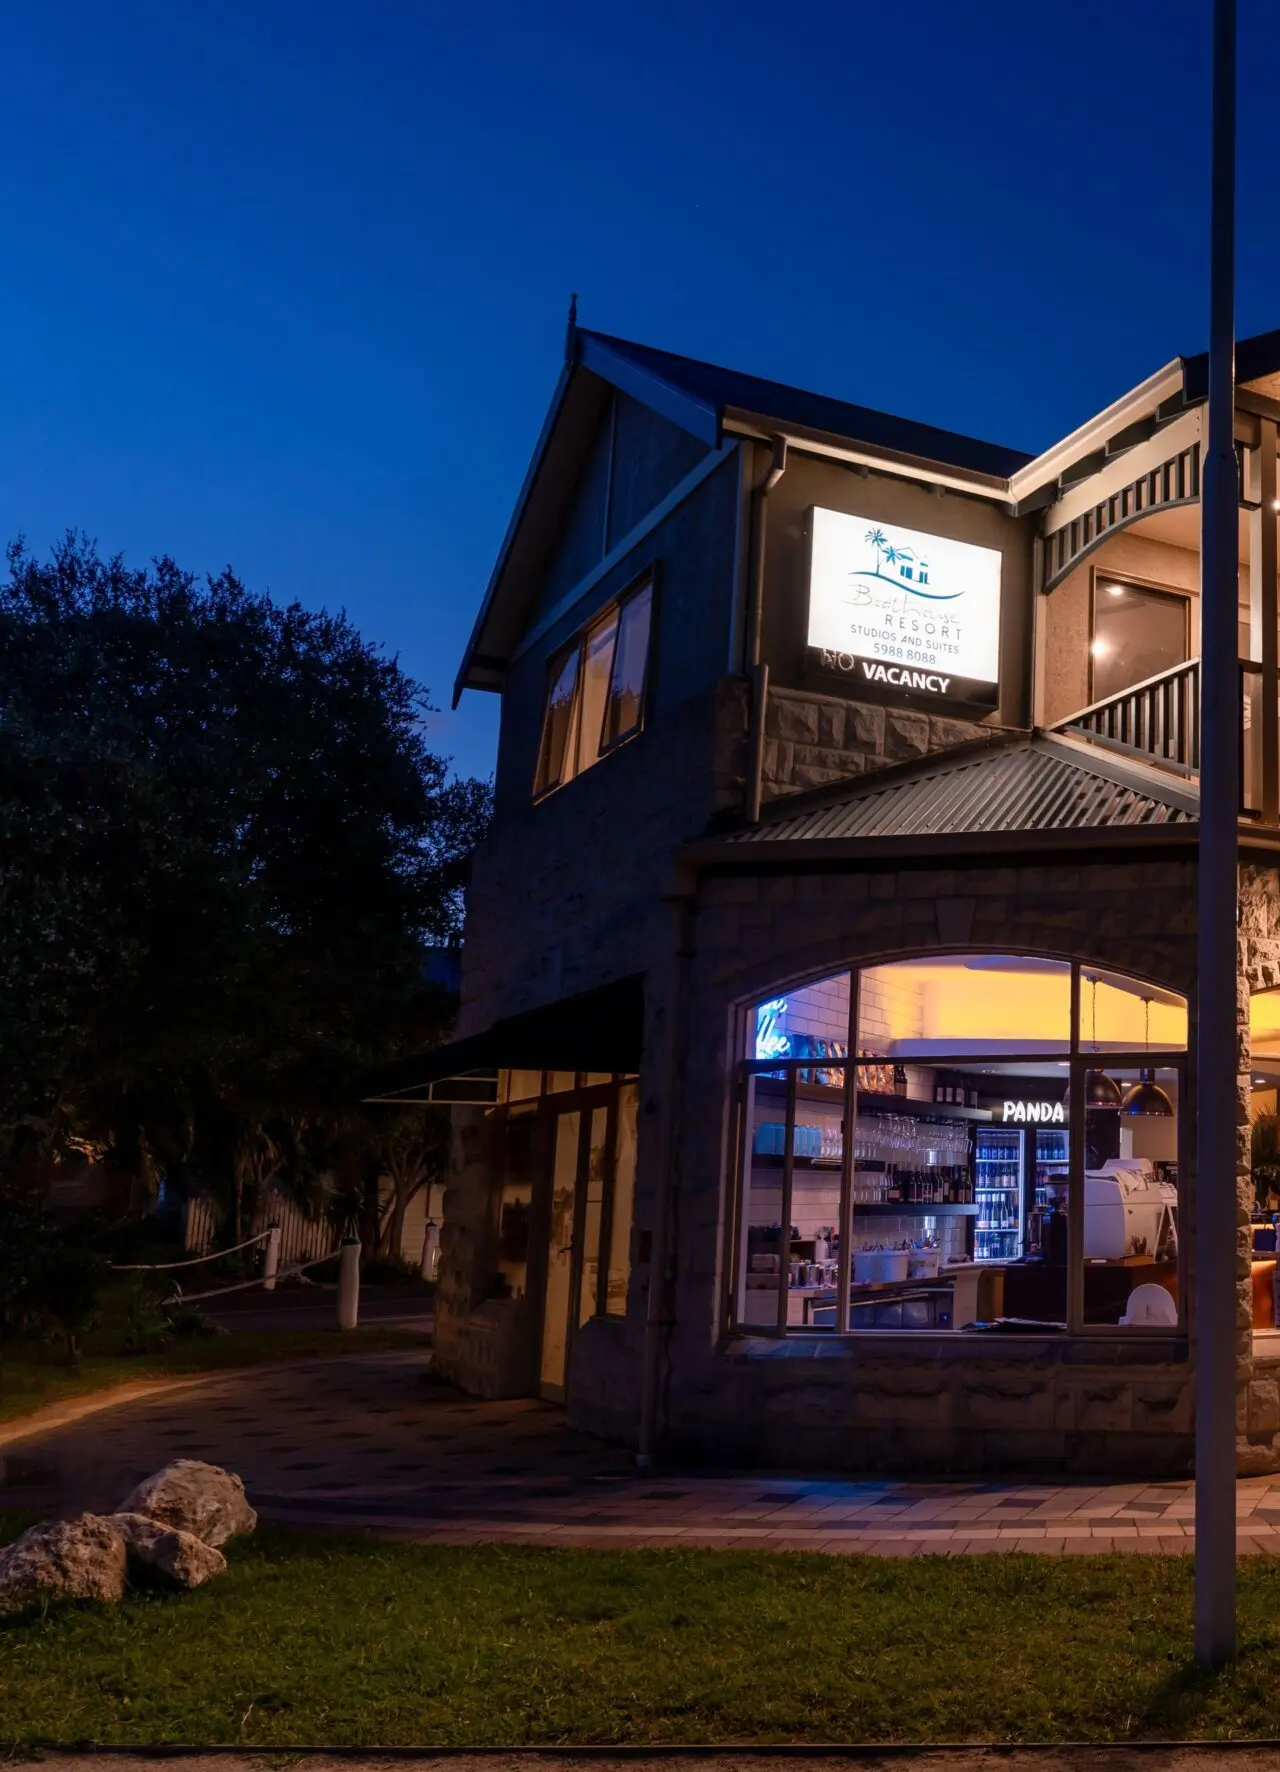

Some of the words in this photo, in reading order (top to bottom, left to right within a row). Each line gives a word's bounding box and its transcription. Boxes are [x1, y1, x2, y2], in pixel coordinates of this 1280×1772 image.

[850, 624, 897, 642] STUDIOS
[901, 635, 922, 647] AND
[926, 639, 959, 655] SUITES
[885, 614, 961, 640] RESORT
[873, 643, 903, 658] 5988
[906, 648, 936, 665] 8088
[862, 662, 950, 693] VACANCY
[1003, 1101, 1064, 1123] PANDA
